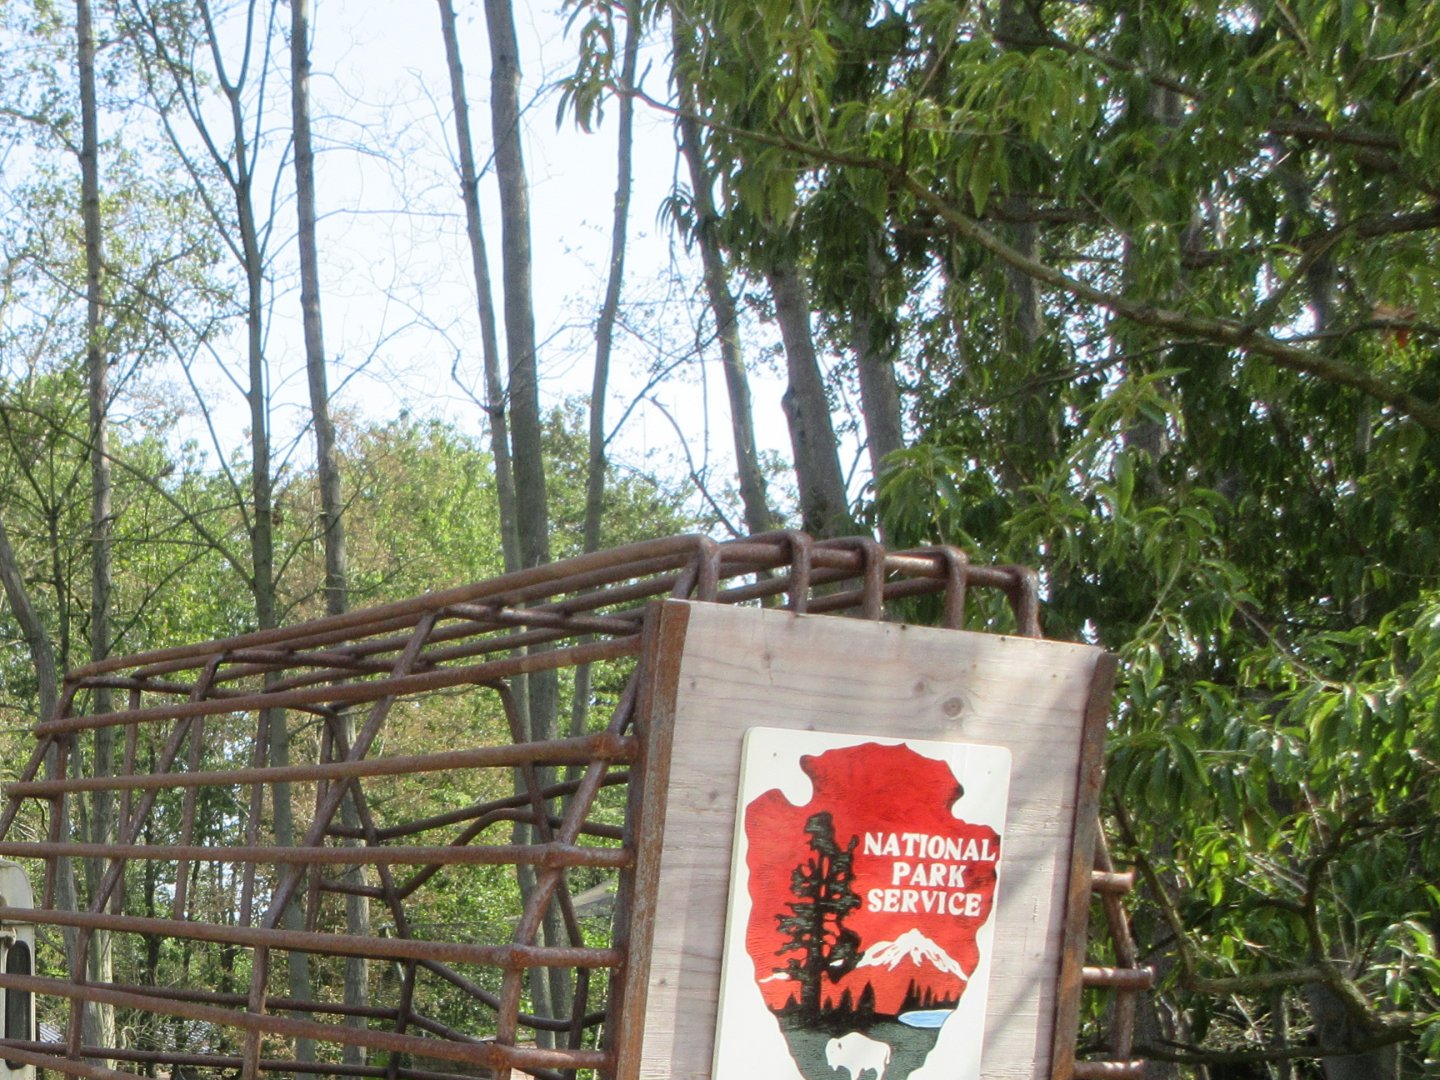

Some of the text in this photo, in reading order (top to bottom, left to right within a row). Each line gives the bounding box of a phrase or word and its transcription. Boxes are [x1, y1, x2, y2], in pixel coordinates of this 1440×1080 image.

[864, 831, 996, 861] NATIONAL
[892, 863, 966, 888] PARK
[867, 888, 982, 916] SERVICE
